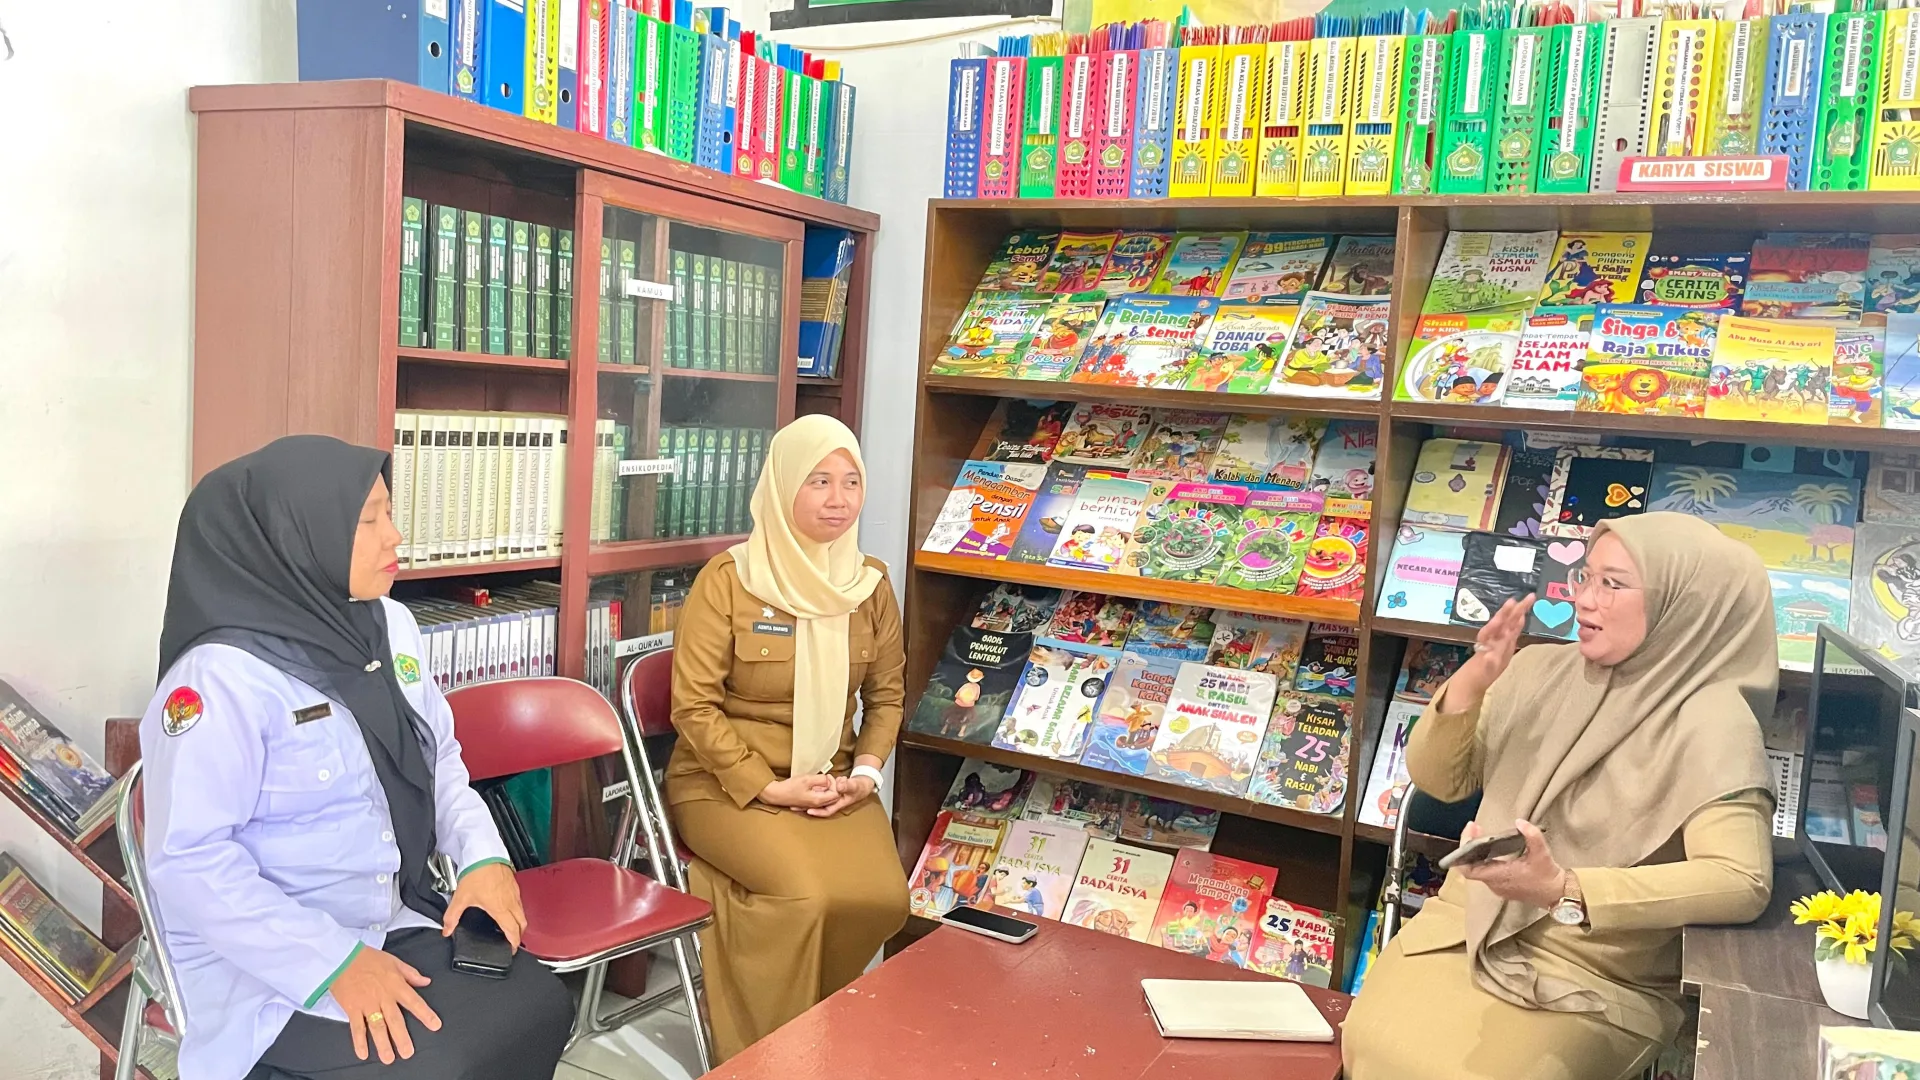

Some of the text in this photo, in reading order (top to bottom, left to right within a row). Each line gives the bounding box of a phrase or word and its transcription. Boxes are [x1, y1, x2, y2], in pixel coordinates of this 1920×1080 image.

[1909, 29, 1918, 49] Kelas
[1426, 40, 1434, 58] ARSIP
[1196, 61, 1204, 77] DATA
[1517, 38, 1529, 102] LAPORAN BULANAN
[1732, 23, 1747, 102] DAFTAR ANGGOTA PERPUS
[1423, 71, 1432, 92] MASUK
[1565, 30, 1583, 148] DAFTAR ANGGOTA PERPUSTAKAAN
[1232, 57, 1247, 140] DATA KELAS (2018/2019)
[1190, 106, 1199, 141] (2018/2019)
[1638, 161, 1765, 178] KARYA SISWA
[1006, 244, 1049, 255] Lebah
[1591, 251, 1636, 259] Dongeng
[1597, 257, 1633, 265] Pilihan
[636, 286, 664, 297] KAMUS
[1666, 279, 1720, 291] CERITA
[1665, 289, 1717, 300] SAINS
[1119, 308, 1191, 328] Belalang
[1129, 325, 1197, 340] & Semut
[1215, 331, 1266, 342] DANAU
[1601, 318, 1679, 339] Singa &
[1212, 341, 1250, 352] TOBA
[1728, 333, 1786, 345] Abu Musa Al
[1602, 341, 1711, 357] Raja Tikus
[1511, 359, 1571, 372] SLAM
[1090, 404, 1139, 419] RASUL
[621, 463, 673, 473] ENSIKLOPEDIA
[977, 468, 1025, 483] Panduan Dasar
[403, 452, 412, 515] ENSIKLOPEDI
[449, 452, 458, 513] ENSIKLOPEDI
[462, 453, 471, 512] ENSIKLOPEDI
[517, 452, 525, 509] ENSIKLOPEDI
[963, 469, 1031, 500] Menggambar
[1213, 468, 1302, 489] Kalah dan Menang
[967, 494, 1028, 519] Pensil
[991, 494, 1013, 503] dengan
[1097, 495, 1144, 506] pintar
[1080, 501, 1142, 517] berhitu
[1168, 508, 1230, 537] KANGKUNG
[1244, 516, 1307, 543] BAYAM
[1396, 562, 1433, 575] NEGARA
[969, 641, 1009, 655] PENYULUT
[968, 651, 1001, 664] LENTERA
[1324, 655, 1359, 666] AL-QUR'A
[1141, 670, 1175, 685] Tongk
[1131, 679, 1174, 694] Kenang
[1199, 678, 1250, 695] 25 NABI
[1040, 662, 1081, 747] MARI BELAJAR SAINS
[1138, 690, 1167, 704] Kake
[1208, 688, 1249, 706] RASUL
[1177, 703, 1258, 726] ANAK SHALEH
[1306, 713, 1336, 727] KISAH
[1298, 721, 1340, 738] TELADAN
[1294, 734, 1331, 763] 25
[1294, 760, 1319, 774] NABI
[604, 785, 631, 798] LAPORAN
[1284, 777, 1316, 793] RASUL
[1028, 835, 1047, 853] 31
[1023, 852, 1044, 861] CERITA
[1111, 856, 1131, 875] 31
[1080, 875, 1115, 893] BADA
[1106, 874, 1129, 884] CERITA
[1187, 873, 1249, 898] Menambang
[1195, 885, 1236, 903] Sampah
[1266, 914, 1292, 932] 25
[1295, 918, 1327, 933] NABI
[1291, 928, 1332, 945] RASUL
